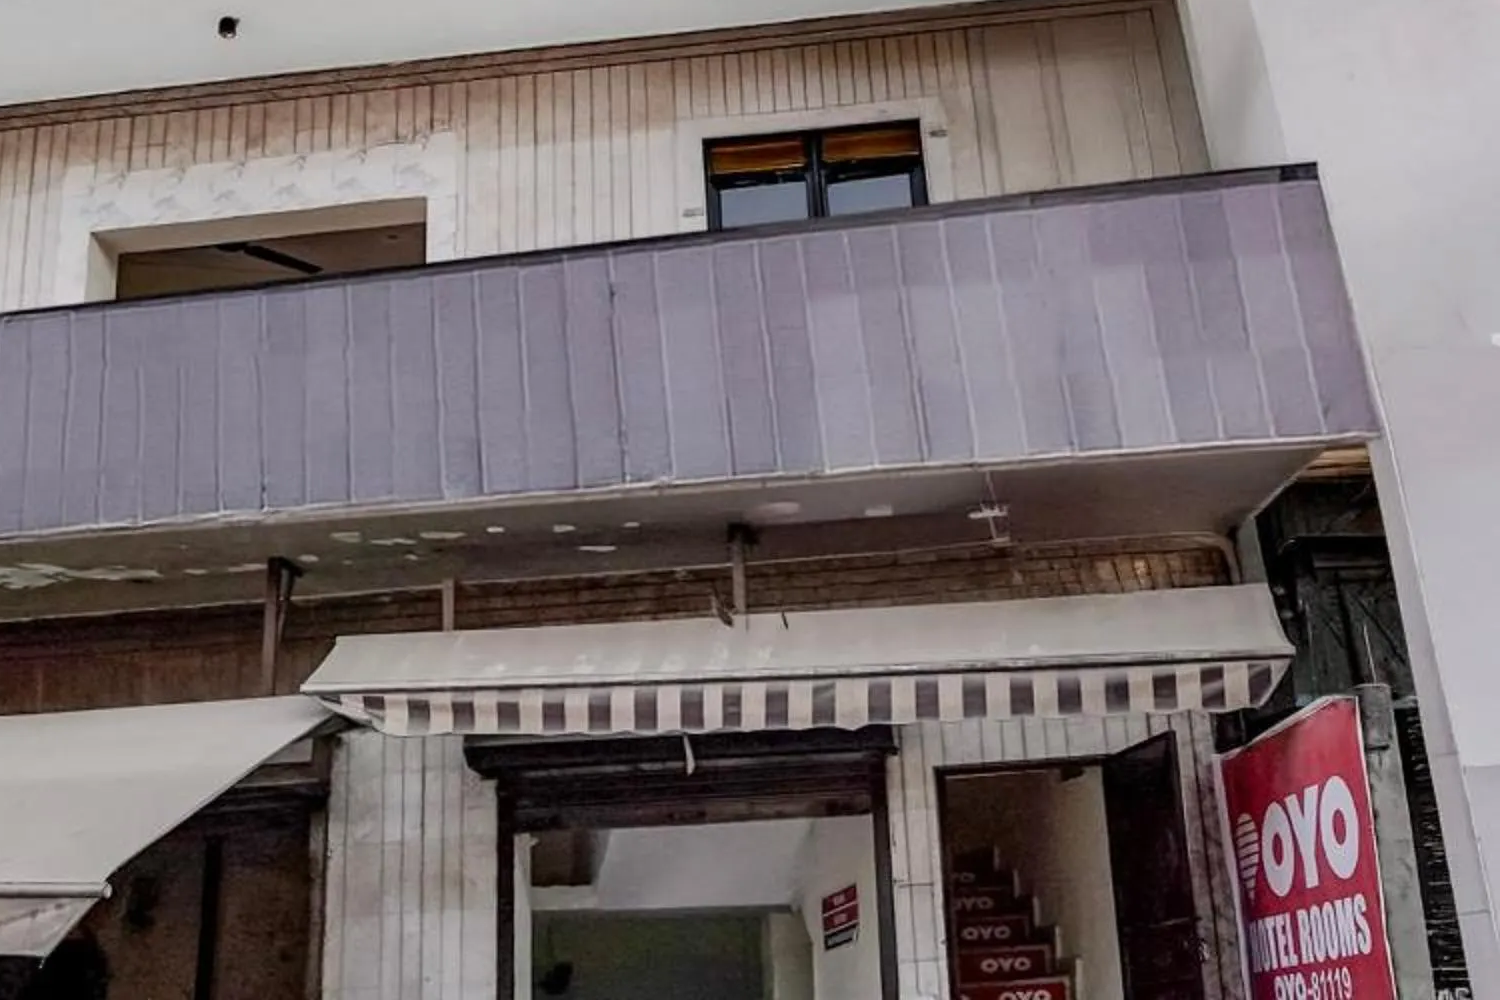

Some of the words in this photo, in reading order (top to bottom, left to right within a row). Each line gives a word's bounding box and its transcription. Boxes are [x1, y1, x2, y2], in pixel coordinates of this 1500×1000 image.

[1261, 775, 1360, 897] OYO
[961, 925, 1011, 940] OYO
[1296, 893, 1372, 965] ROOMS
[980, 956, 1031, 973] OYO
[1274, 966, 1353, 1000] OYO-81119
